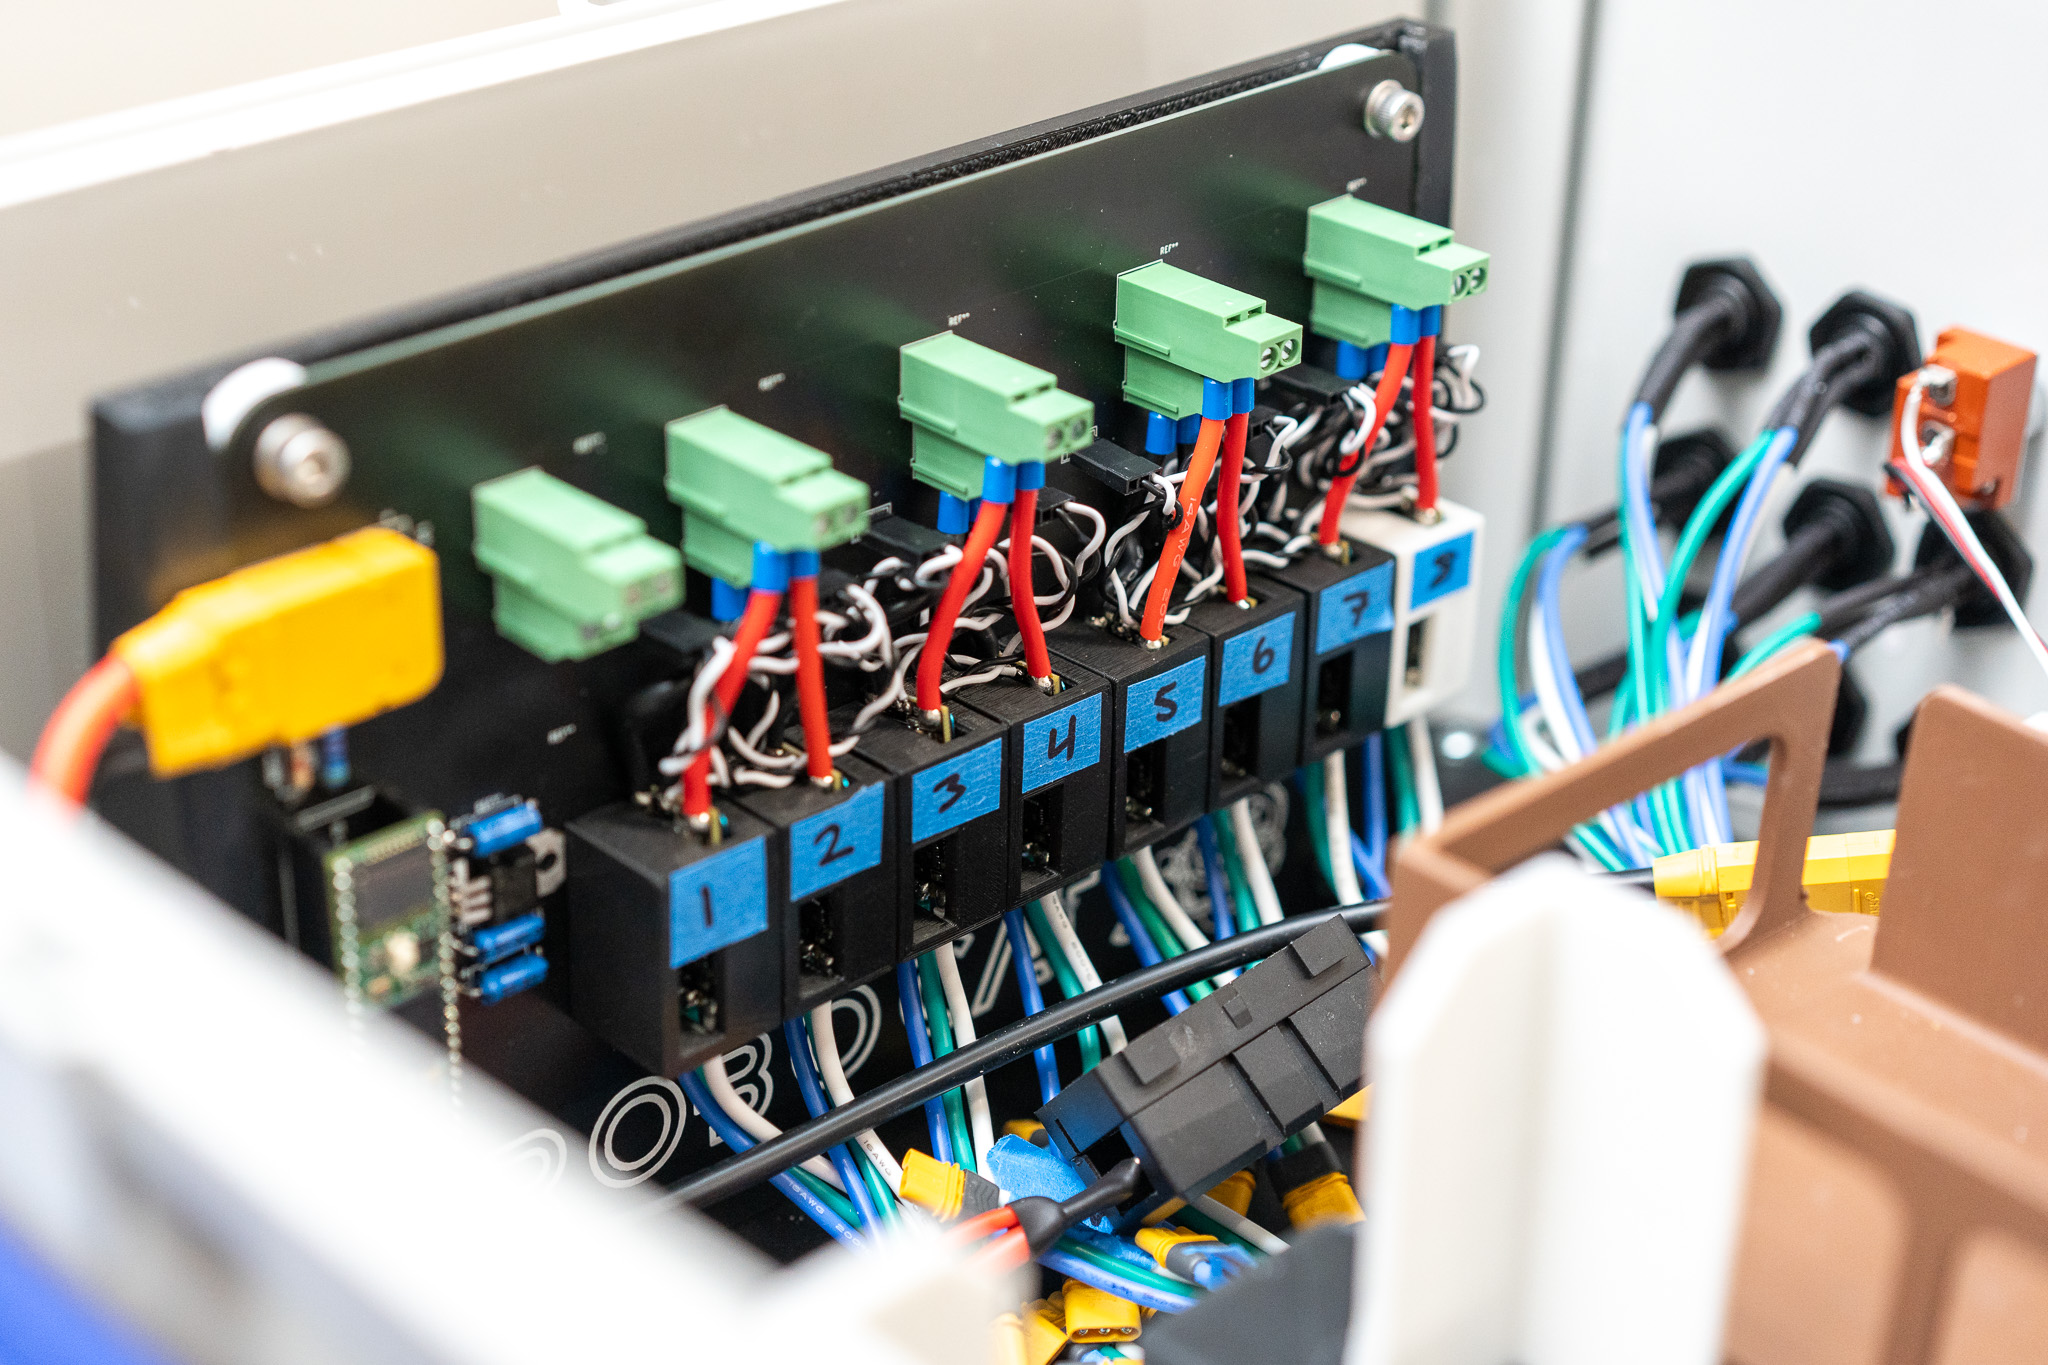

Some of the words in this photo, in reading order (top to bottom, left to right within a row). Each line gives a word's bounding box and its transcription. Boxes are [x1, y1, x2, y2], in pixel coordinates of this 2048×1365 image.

[1342, 590, 1369, 625] 7
[1252, 636, 1275, 675] 6
[1153, 681, 1178, 723] 5
[1047, 714, 1077, 762] 4
[932, 772, 967, 814] 3
[814, 823, 855, 867] 2
[701, 886, 713, 927] 1
[863, 1139, 892, 1177] 16AWG
[788, 1181, 825, 1215] 16AWG
